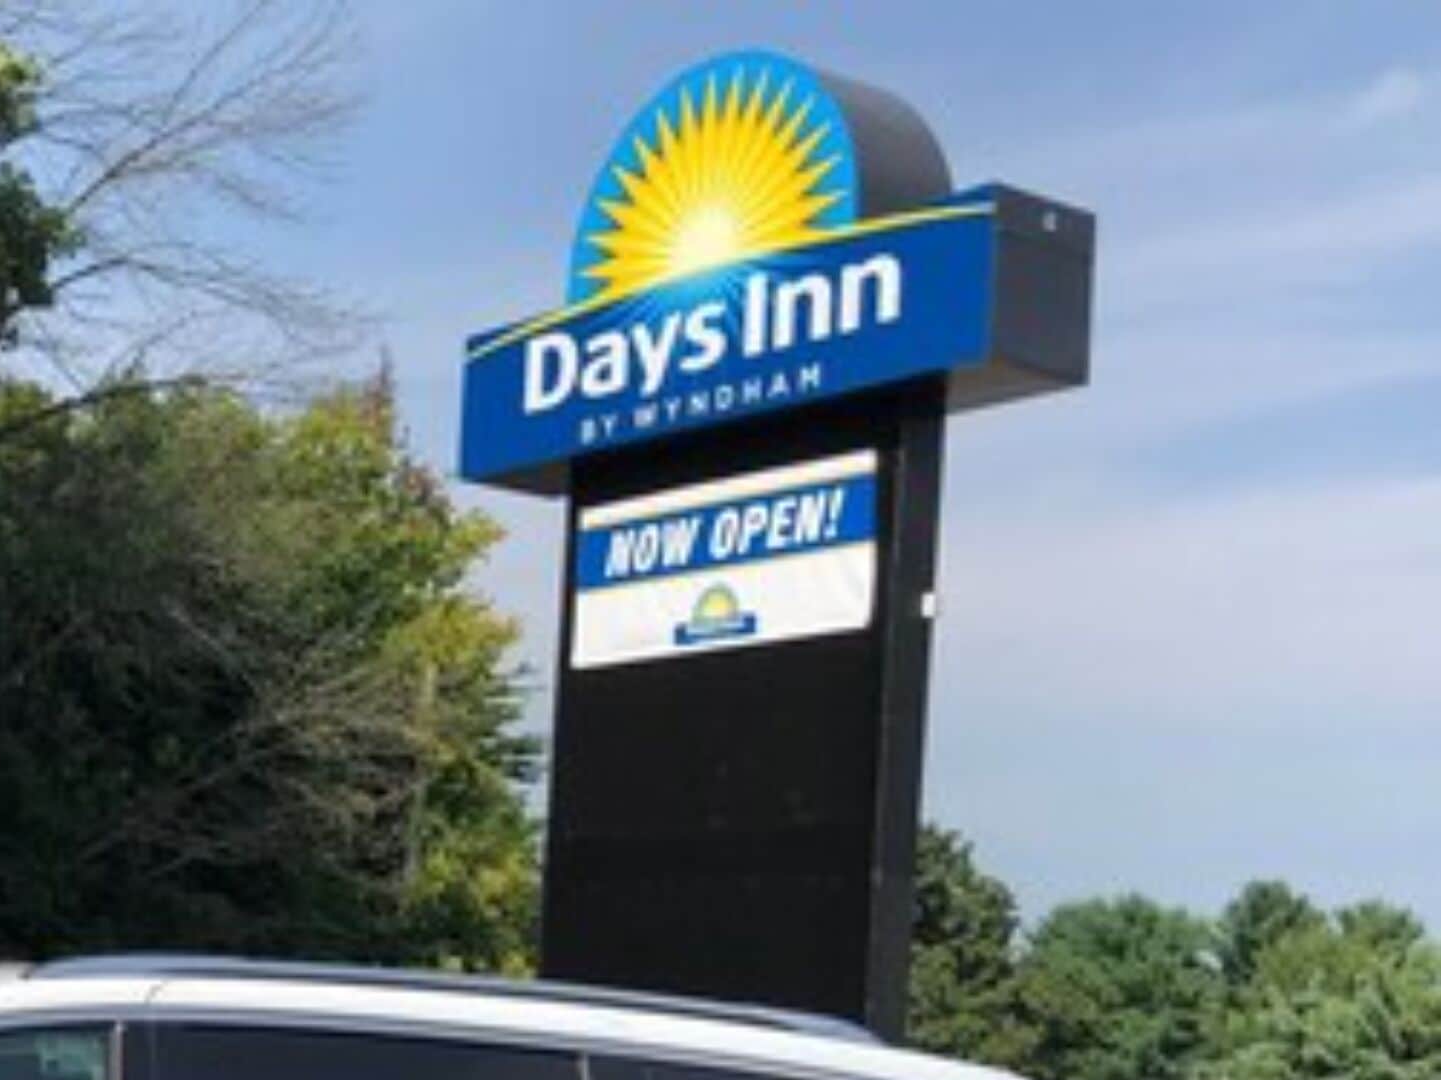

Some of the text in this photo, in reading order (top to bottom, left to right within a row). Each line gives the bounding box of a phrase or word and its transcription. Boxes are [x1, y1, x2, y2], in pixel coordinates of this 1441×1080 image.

[523, 253, 902, 417] Days Inn
[580, 364, 822, 444] BY WYNDHAM
[604, 488, 844, 578] NOW OPEN!
